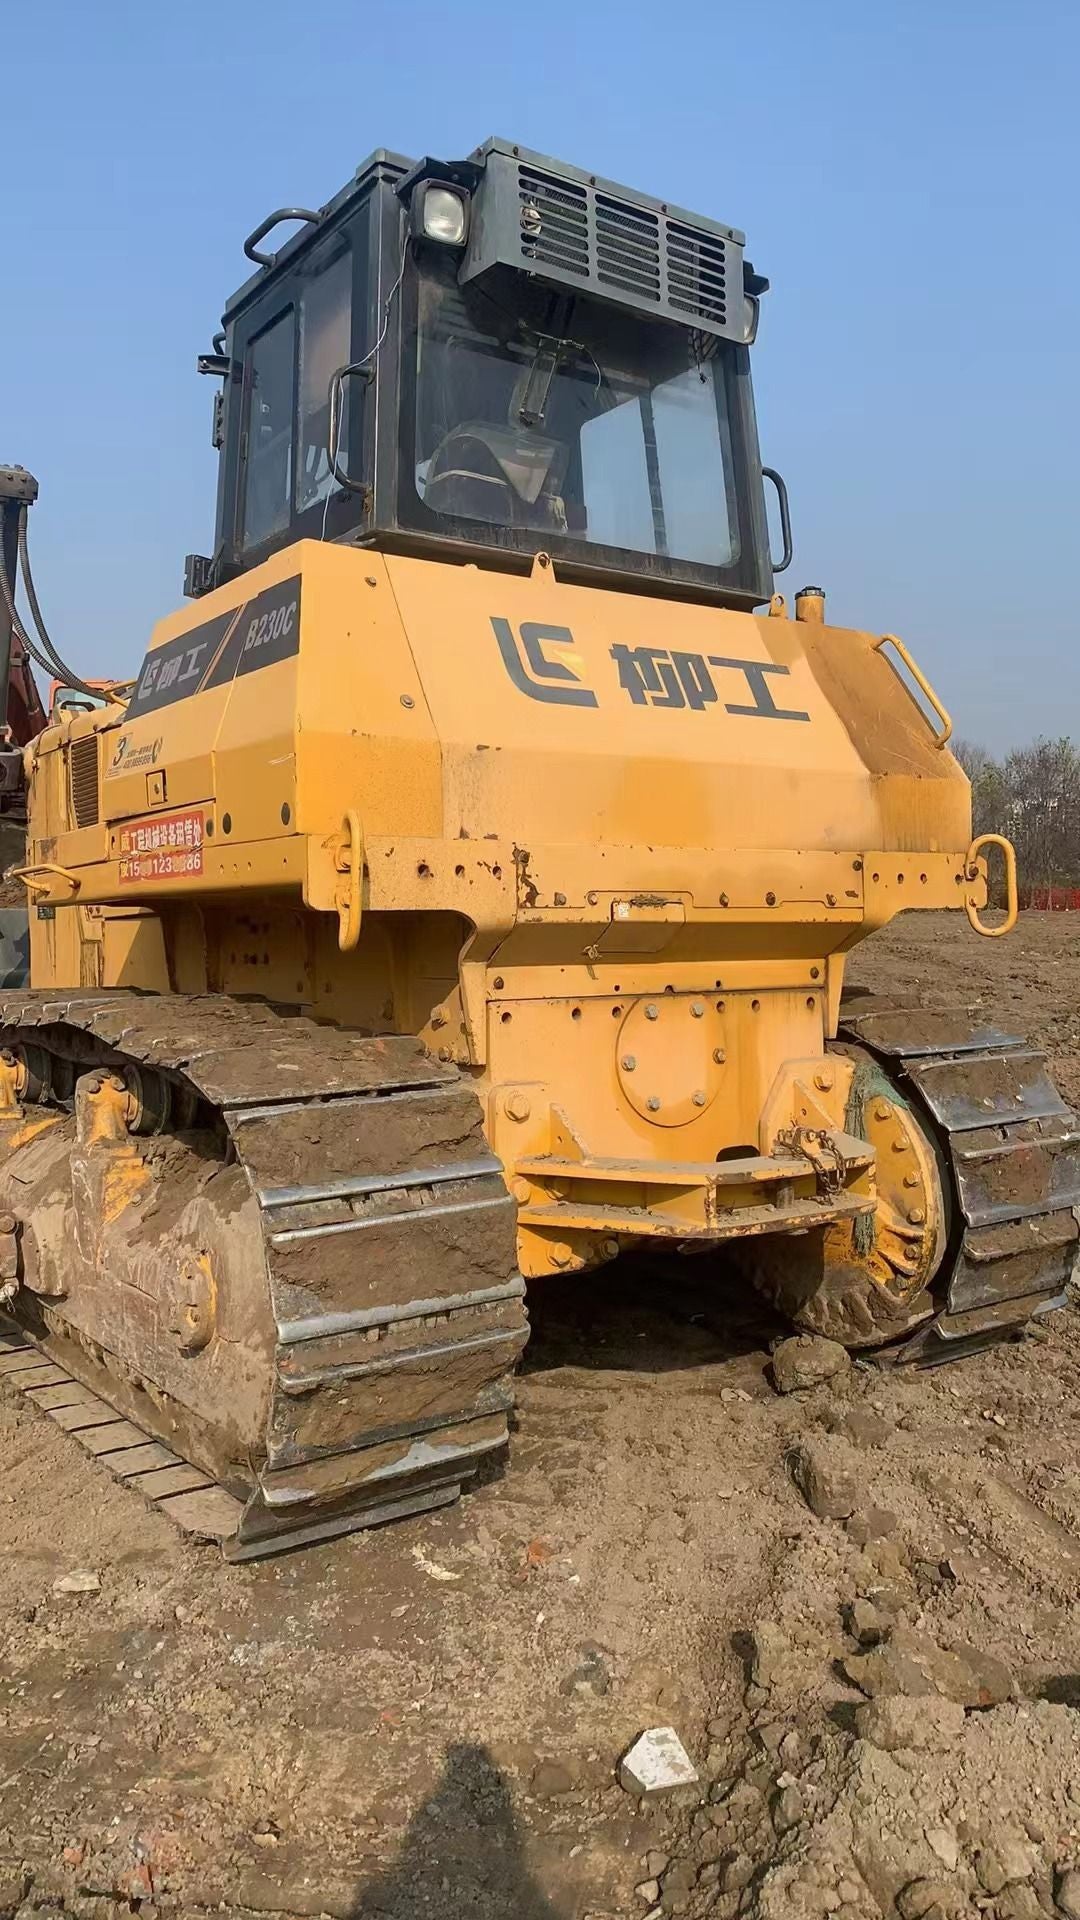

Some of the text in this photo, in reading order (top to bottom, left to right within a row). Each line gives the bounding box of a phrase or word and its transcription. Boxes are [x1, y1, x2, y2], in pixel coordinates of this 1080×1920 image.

[244, 601, 297, 651] B230C
[155, 642, 208, 692] 柳工
[608, 643, 811, 721] 柳工
